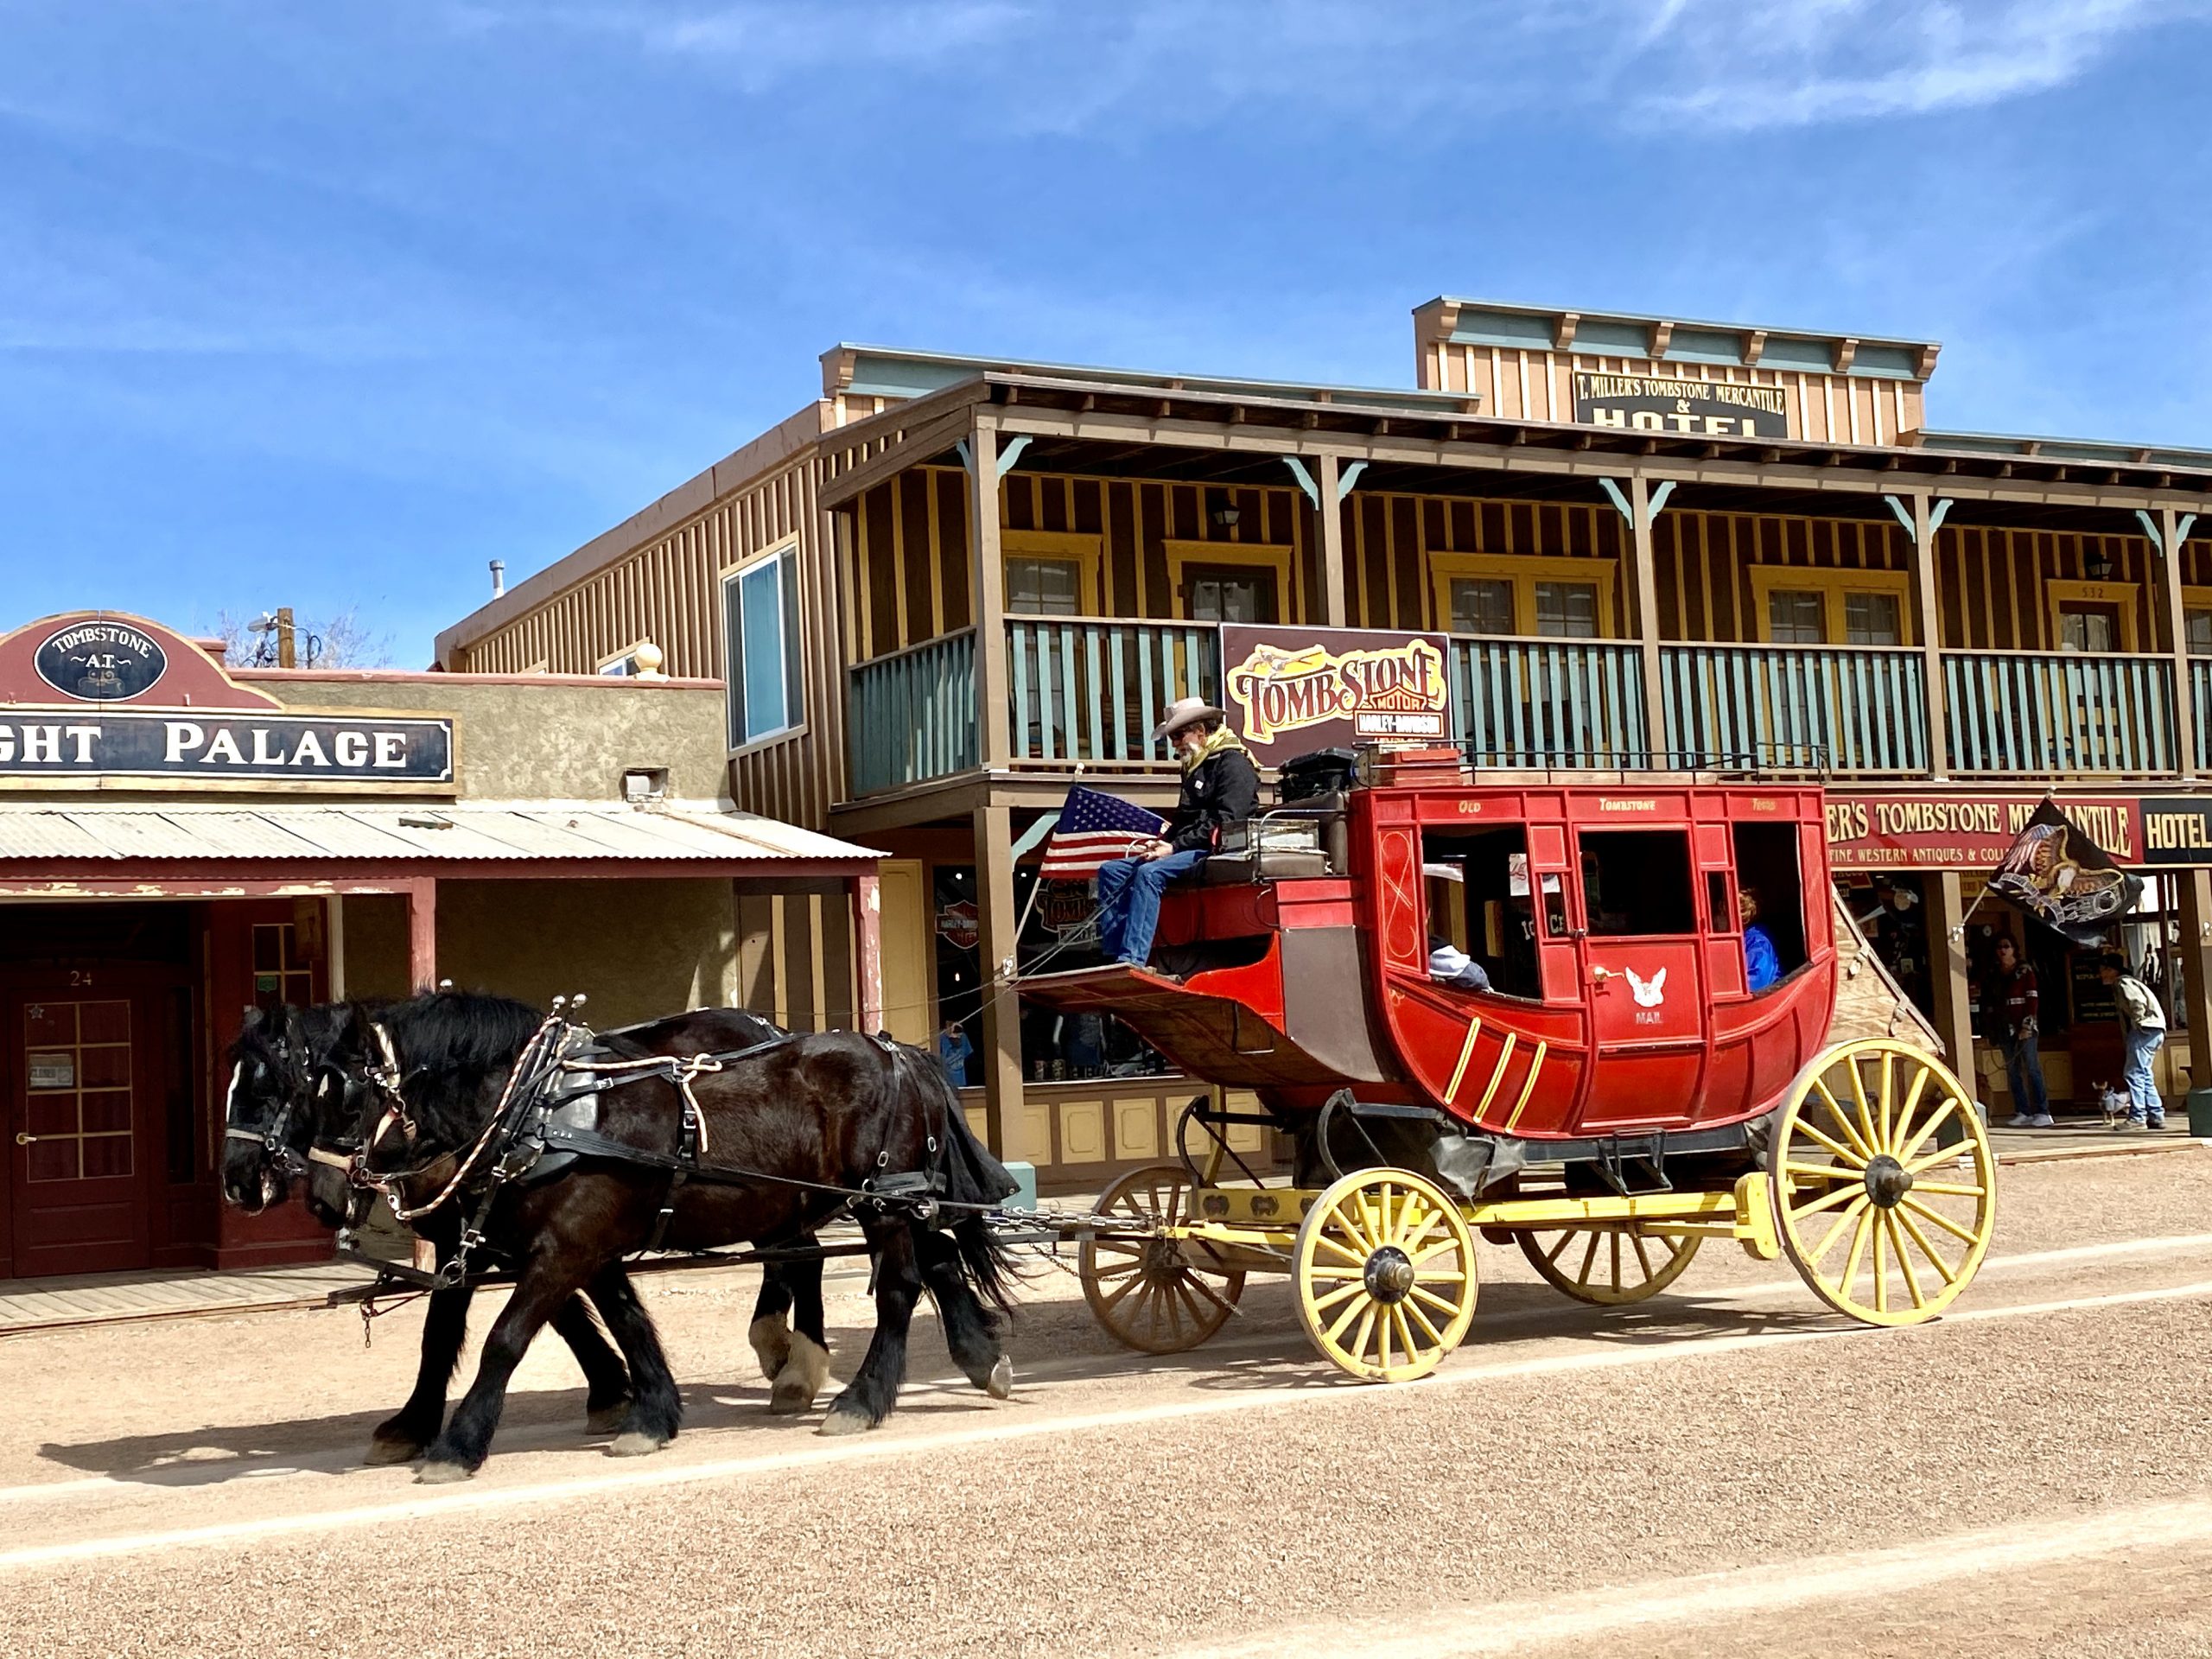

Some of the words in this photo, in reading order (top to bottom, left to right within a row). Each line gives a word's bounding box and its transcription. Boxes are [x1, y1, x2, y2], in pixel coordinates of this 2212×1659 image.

[1590, 375, 1642, 398] MILLER'S
[1643, 380, 1711, 401] TOMBSTONE
[1715, 385, 1784, 416] MERCANTILE
[1676, 398, 1691, 413] &
[52, 627, 152, 658] TOMBSTONE
[86, 654, 115, 669] A.T.
[1236, 647, 1440, 734] TOMBSTONE
[1377, 690, 1421, 710] MOTOR
[163, 721, 407, 767] PALACE
[1459, 800, 1482, 814] OLD
[1599, 798, 1656, 812] TOMBSTONE
[1825, 800, 1870, 844] ER'S
[1876, 802, 2002, 835] TOMBSTONE
[2007, 804, 2132, 859] MEANTILE
[2145, 813, 2212, 849] HOTEL
[1829, 849, 1853, 862] FINE
[1859, 848, 1908, 862] WESTERN
[1912, 847, 1964, 862] ANTIQUES
[1967, 848, 1976, 861] &
[1980, 848, 2010, 861] COLL
[70, 970, 92, 987] 24
[1636, 1011, 1664, 1024] MAIL
